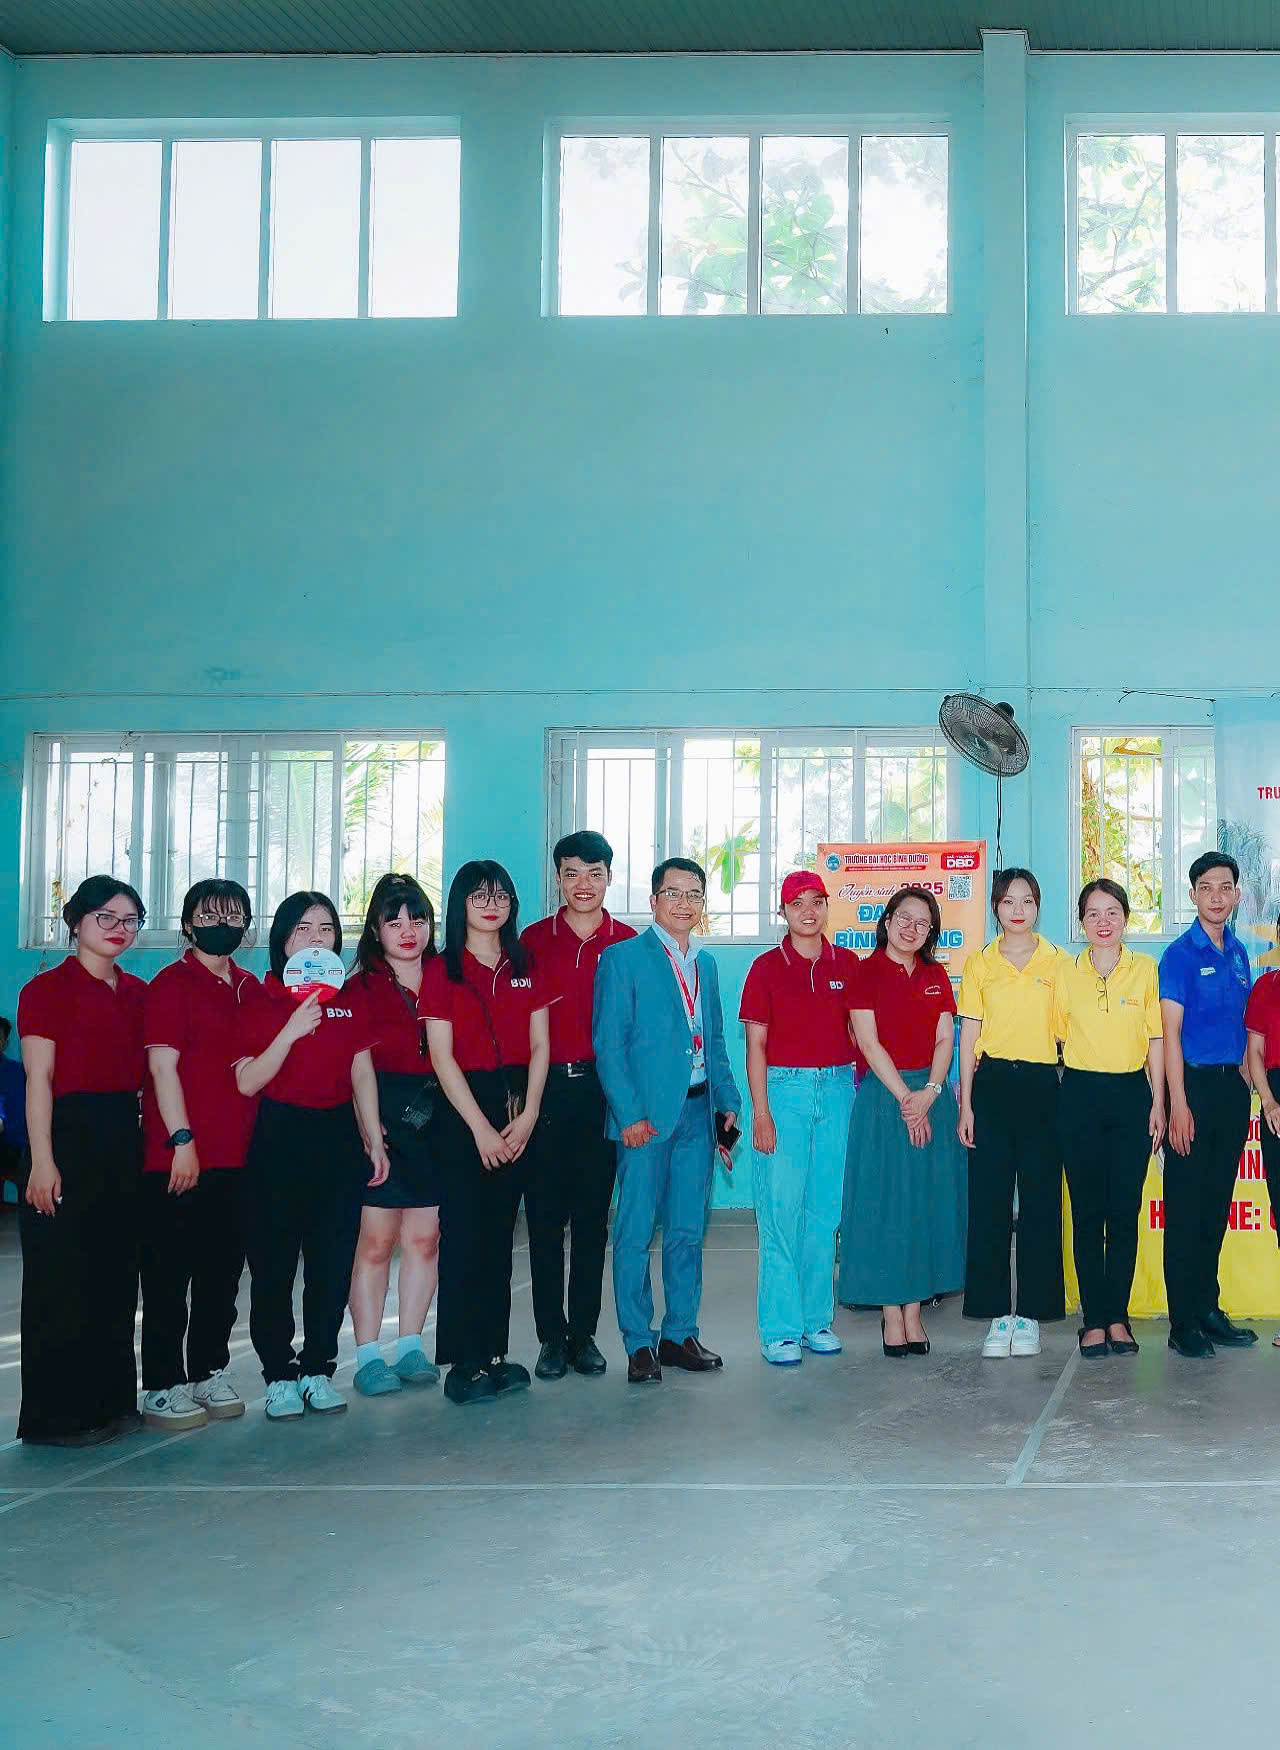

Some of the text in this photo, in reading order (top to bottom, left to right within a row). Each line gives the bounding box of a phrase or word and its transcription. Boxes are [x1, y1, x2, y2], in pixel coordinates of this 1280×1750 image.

[946, 859, 975, 868] DBD
[510, 978, 532, 988] BDU
[829, 981, 844, 990] BD
[326, 1008, 353, 1018] BDU
